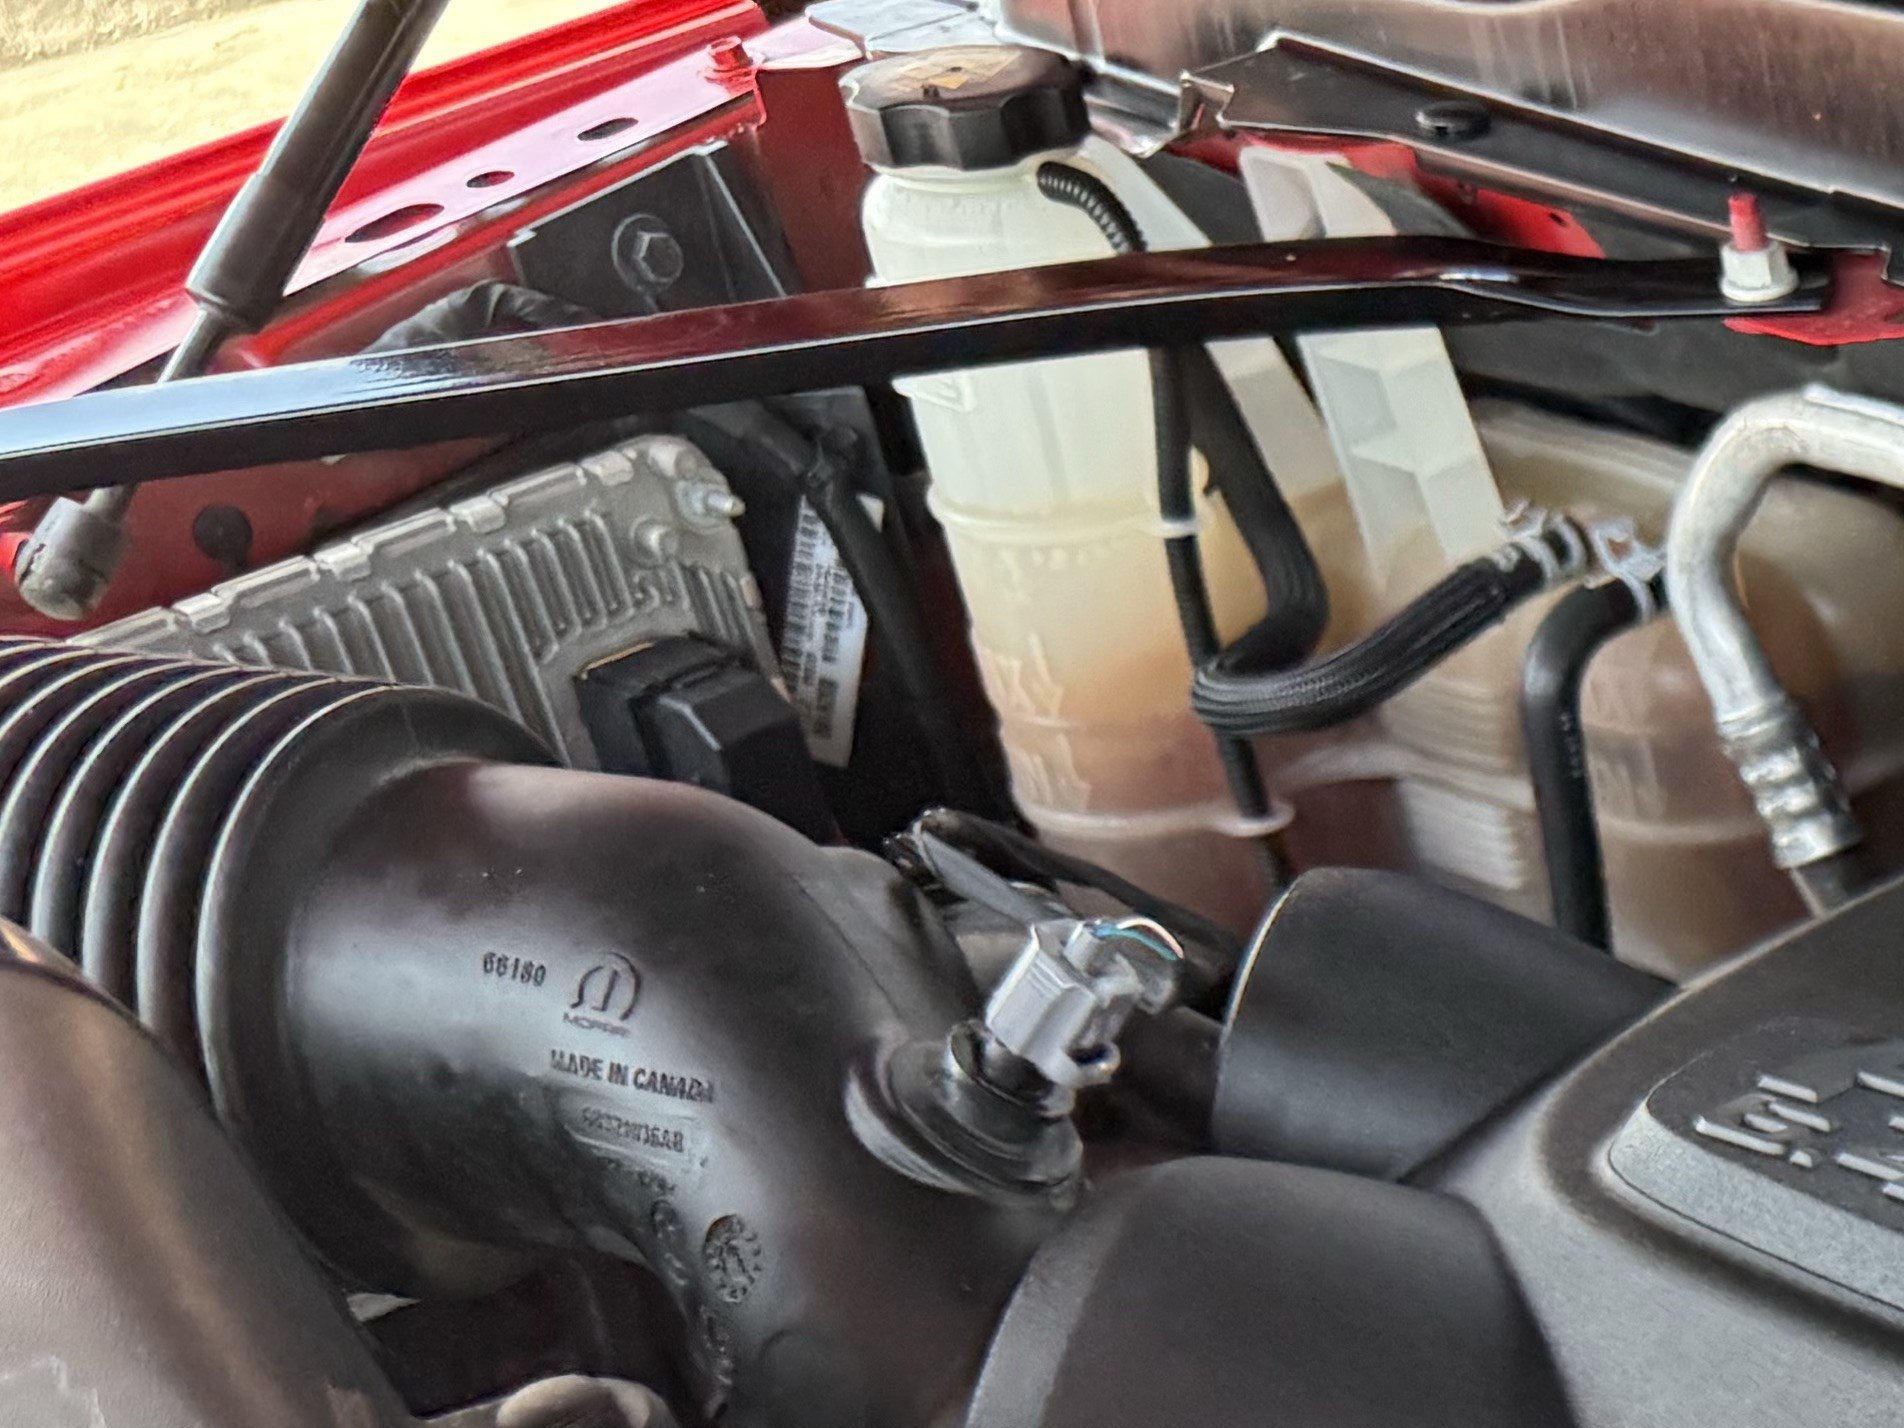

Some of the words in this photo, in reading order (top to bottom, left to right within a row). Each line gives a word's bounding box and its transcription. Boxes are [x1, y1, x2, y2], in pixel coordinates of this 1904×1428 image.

[552, 1049, 603, 1081] MADE
[608, 1062, 629, 1087] IN
[633, 1068, 714, 1103] CANADA
